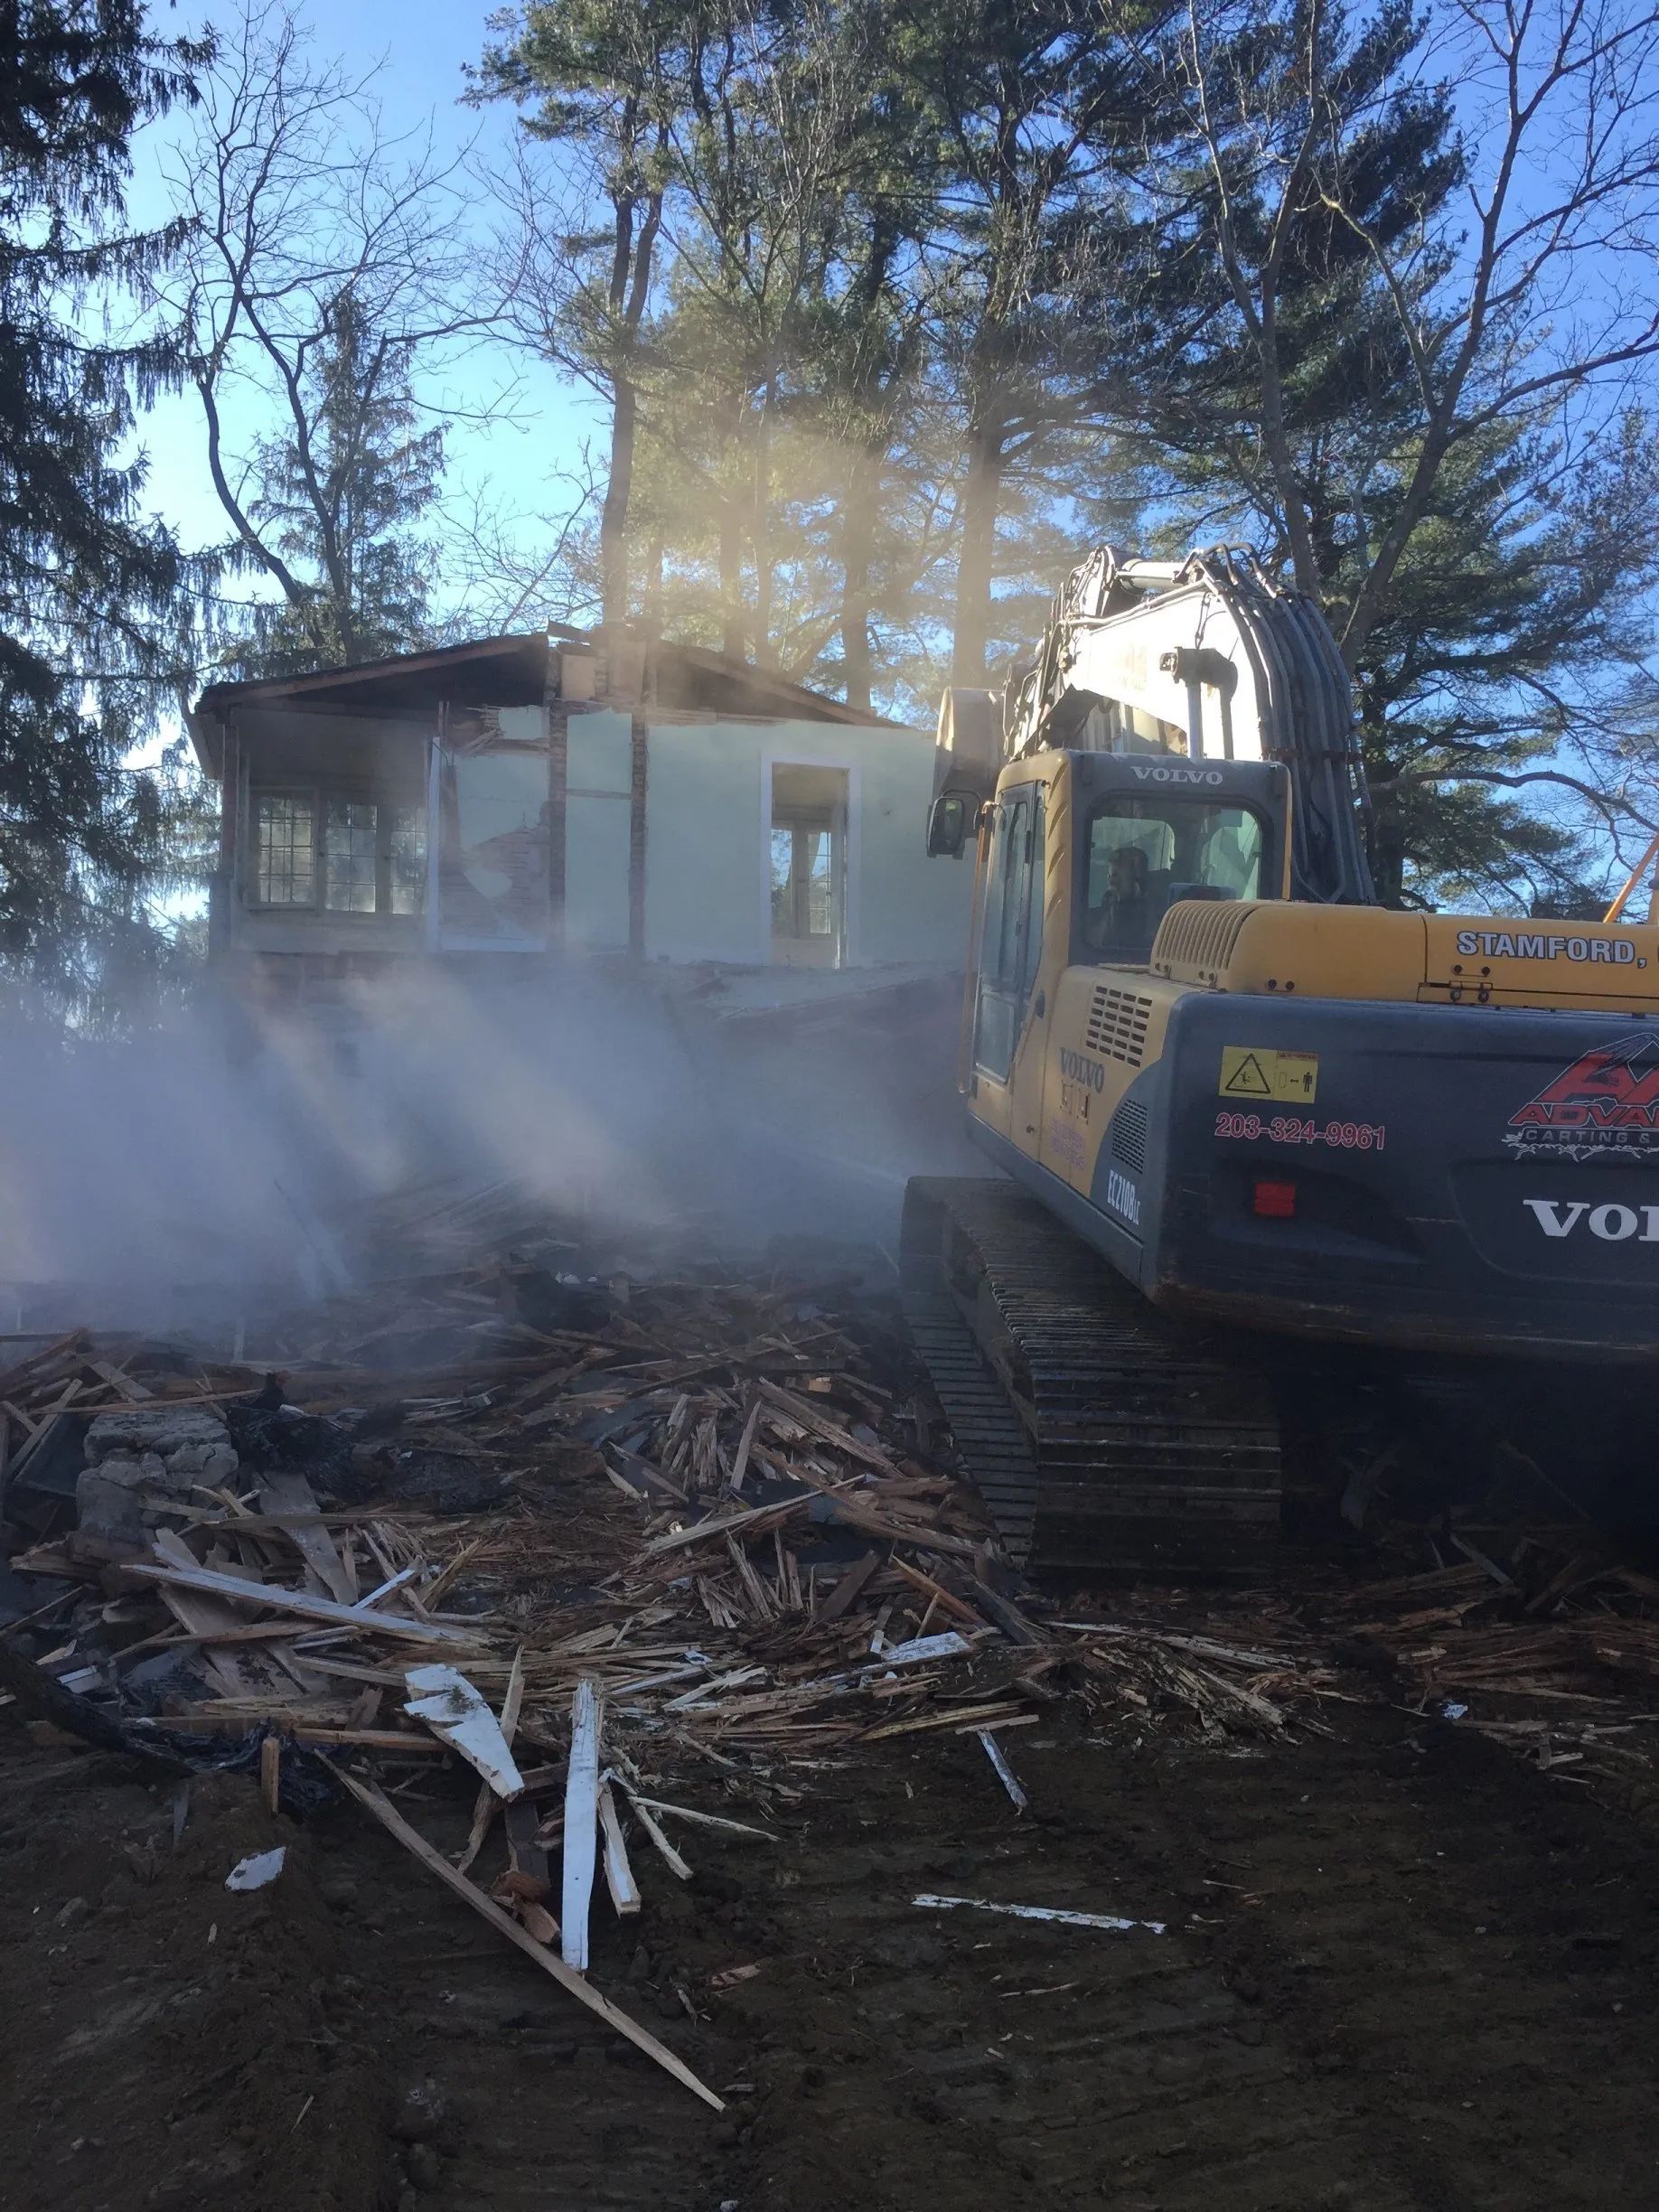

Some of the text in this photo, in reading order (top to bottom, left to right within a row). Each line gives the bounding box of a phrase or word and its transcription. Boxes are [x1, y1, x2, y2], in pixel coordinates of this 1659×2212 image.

[1130, 766, 1223, 785] VOLVO
[1457, 931, 1647, 969] STAMFORD,
[1060, 1046, 1105, 1093] VOLVO
[1214, 1112, 1385, 1150] 203-324-9961
[1508, 1103, 1659, 1129] ADVA
[1525, 1129, 1651, 1144] CARTING &
